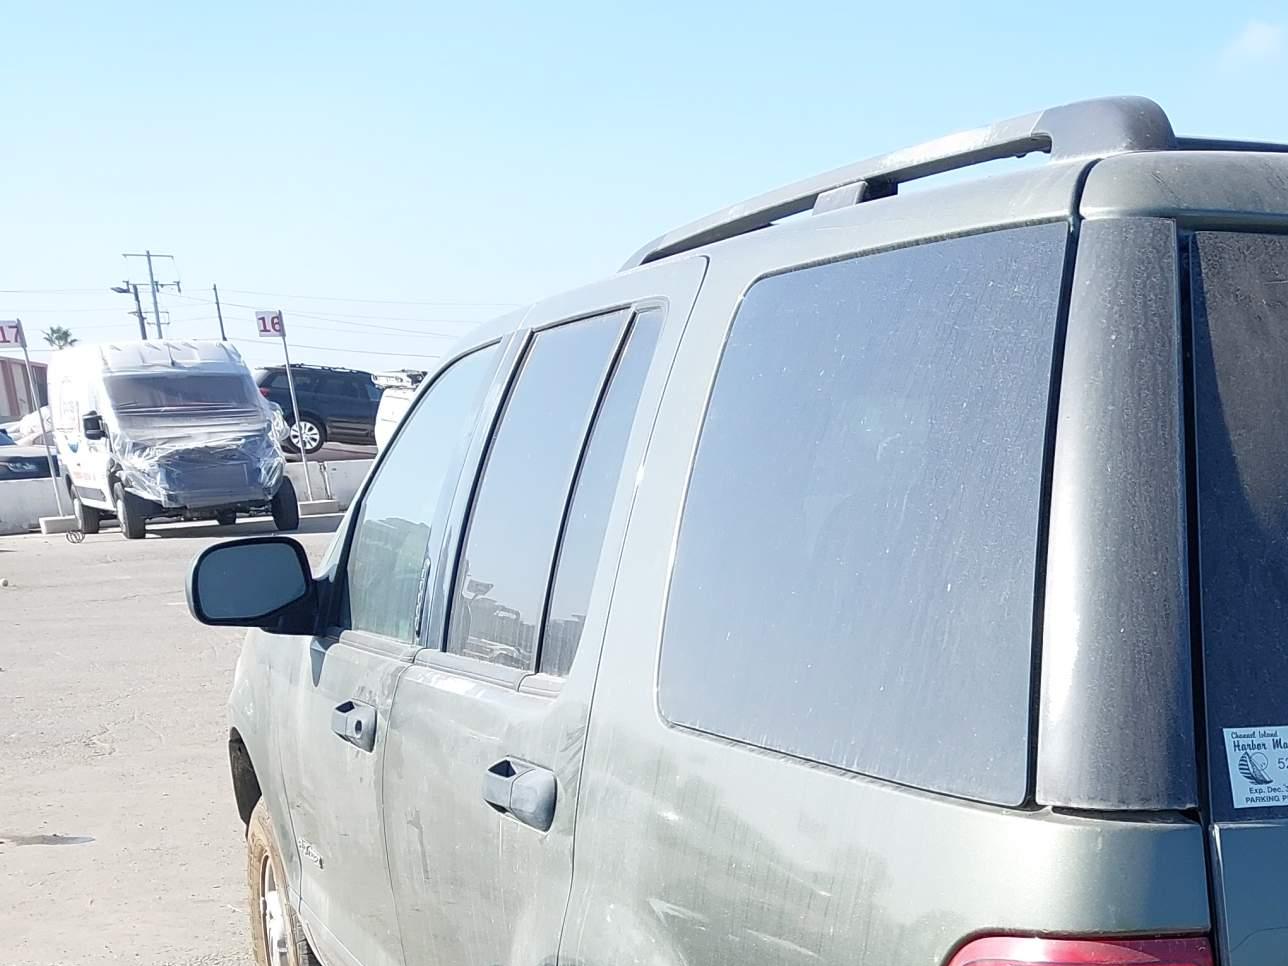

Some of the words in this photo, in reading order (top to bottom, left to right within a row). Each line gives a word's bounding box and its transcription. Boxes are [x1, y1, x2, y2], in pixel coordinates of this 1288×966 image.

[258, 315, 281, 332] 16
[0, 325, 19, 343] 17
[1233, 740, 1267, 752] Harbor
[1246, 795, 1280, 803] PARKING
